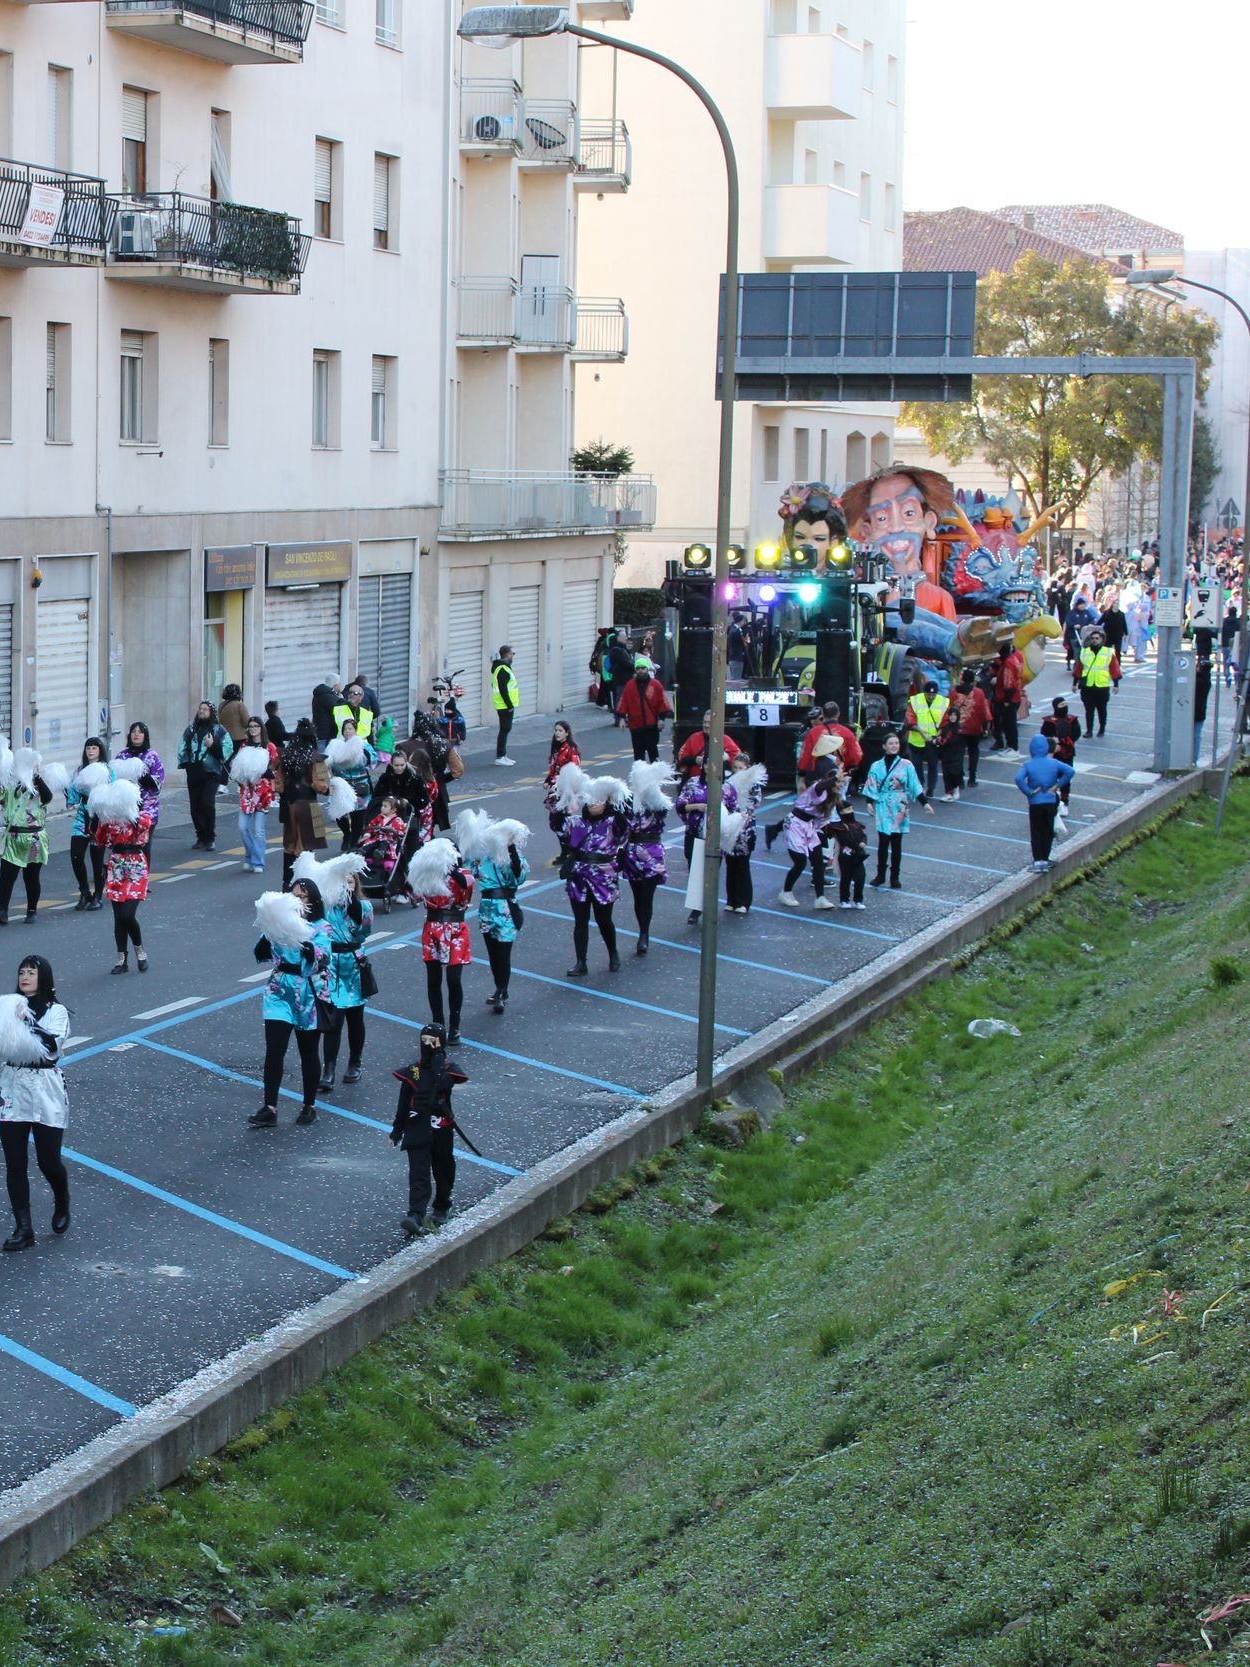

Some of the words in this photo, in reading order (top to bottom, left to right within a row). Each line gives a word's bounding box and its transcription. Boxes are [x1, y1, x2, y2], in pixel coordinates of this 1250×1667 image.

[30, 208, 57, 227] VENDESI
[285, 552, 294, 565] SAN
[295, 552, 317, 564] VINCENZO
[759, 708, 768, 721] 8
